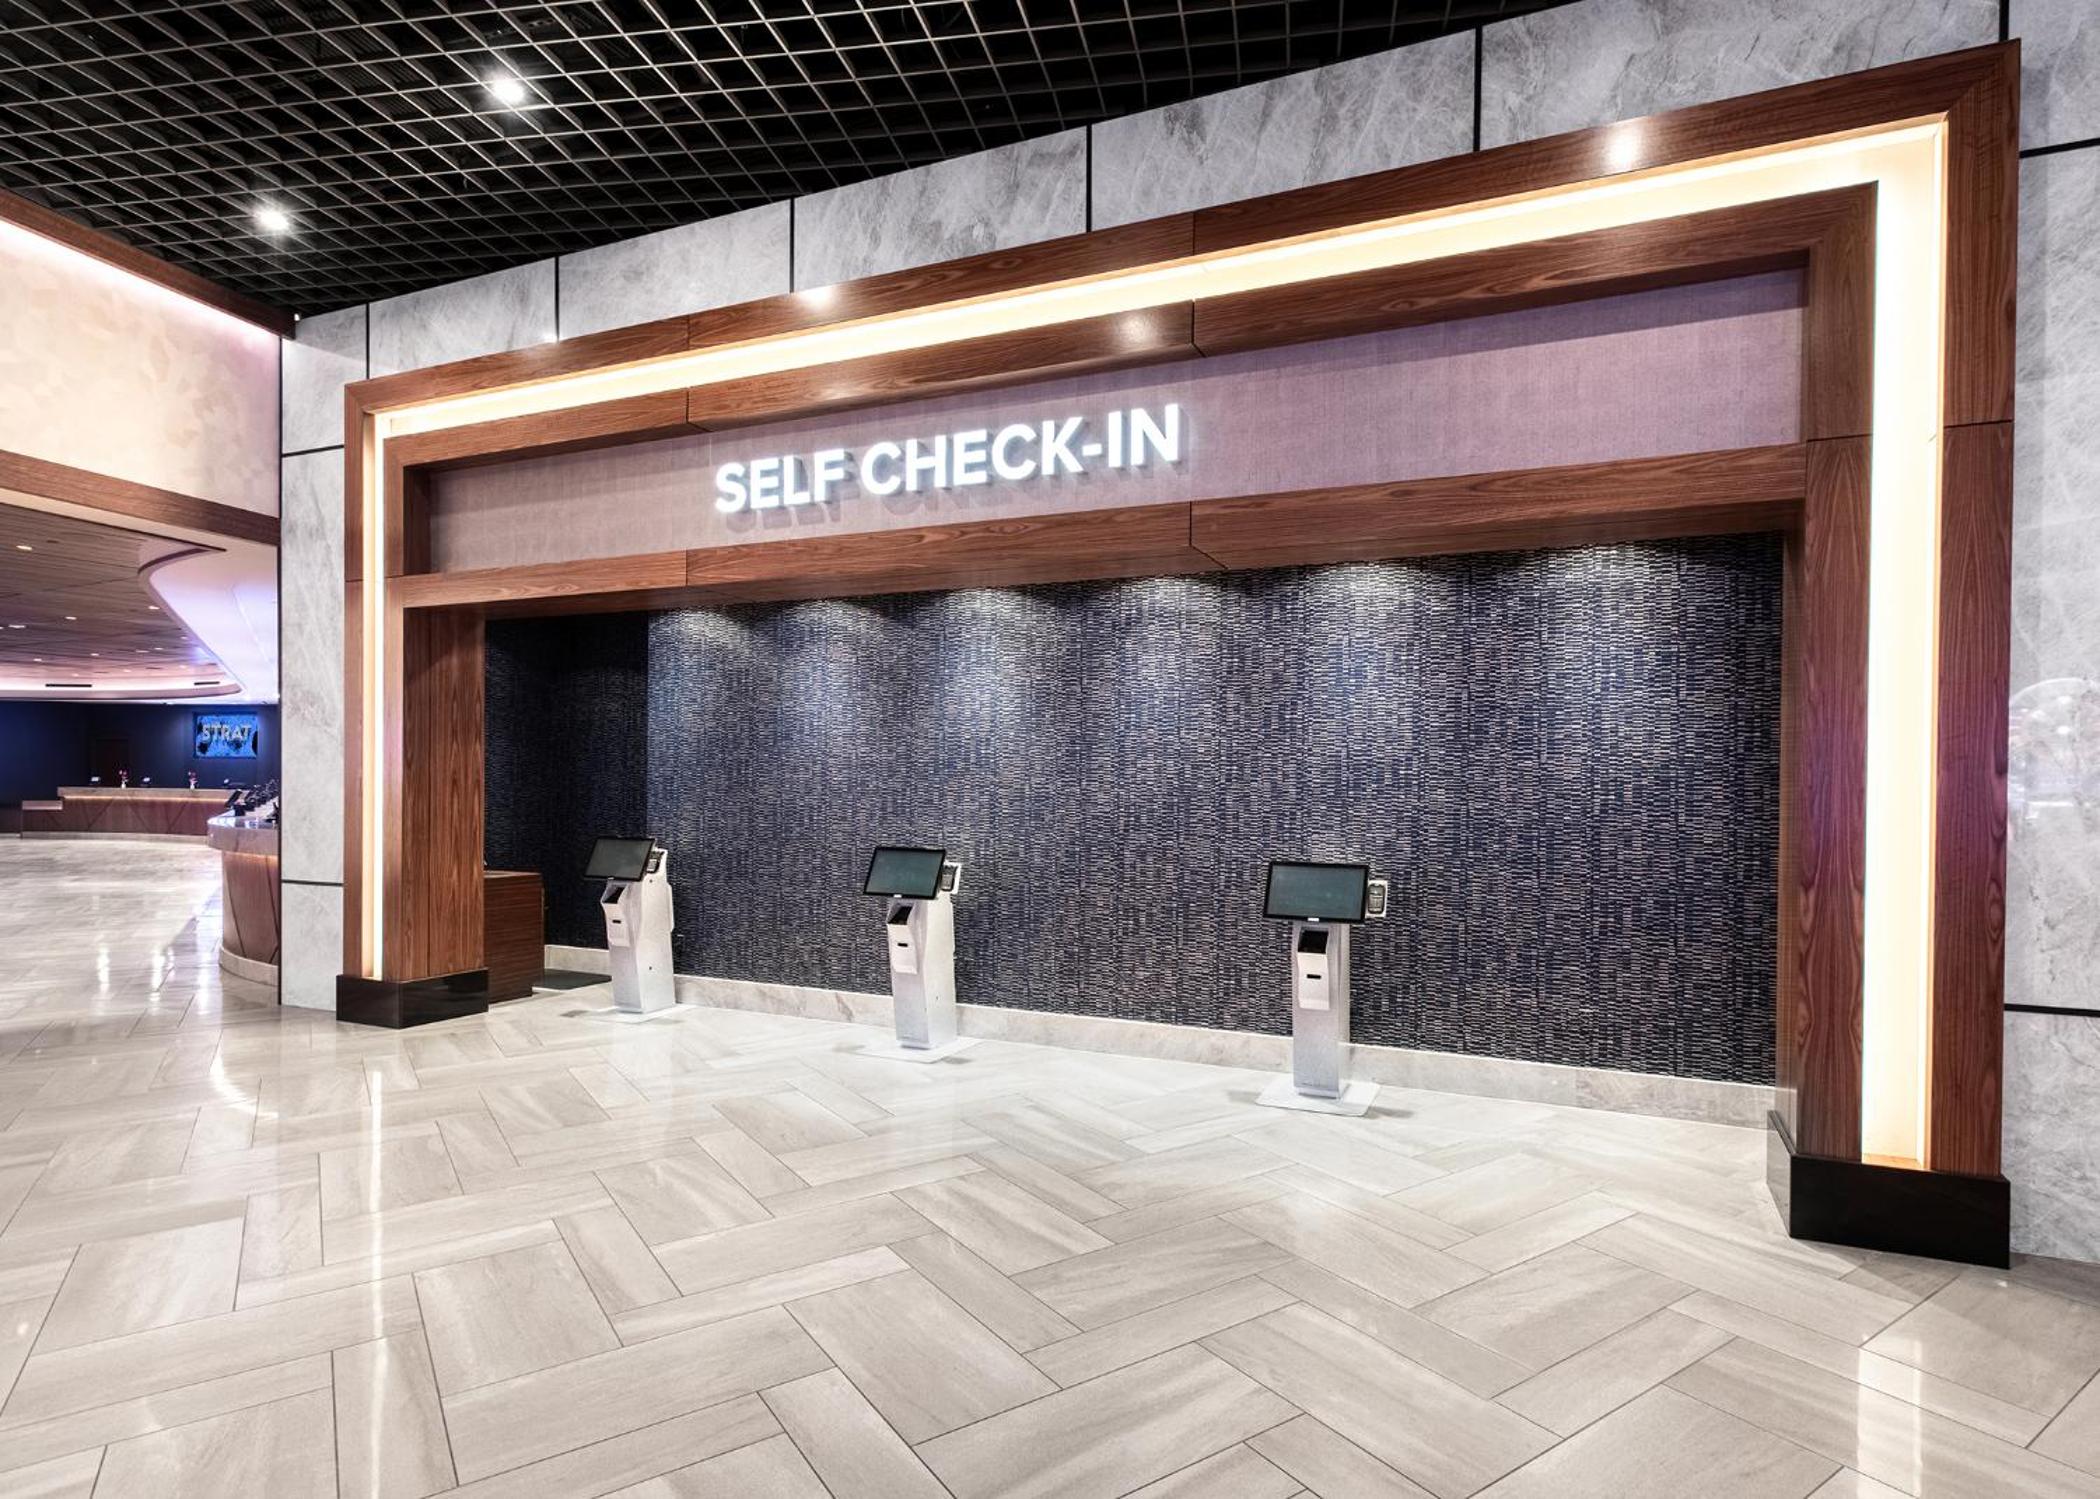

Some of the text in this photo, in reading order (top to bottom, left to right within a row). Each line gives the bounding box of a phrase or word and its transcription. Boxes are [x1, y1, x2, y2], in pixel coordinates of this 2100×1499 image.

[715, 404, 1180, 514] SELF CHECK-IN
[202, 722, 251, 742] STRAT
